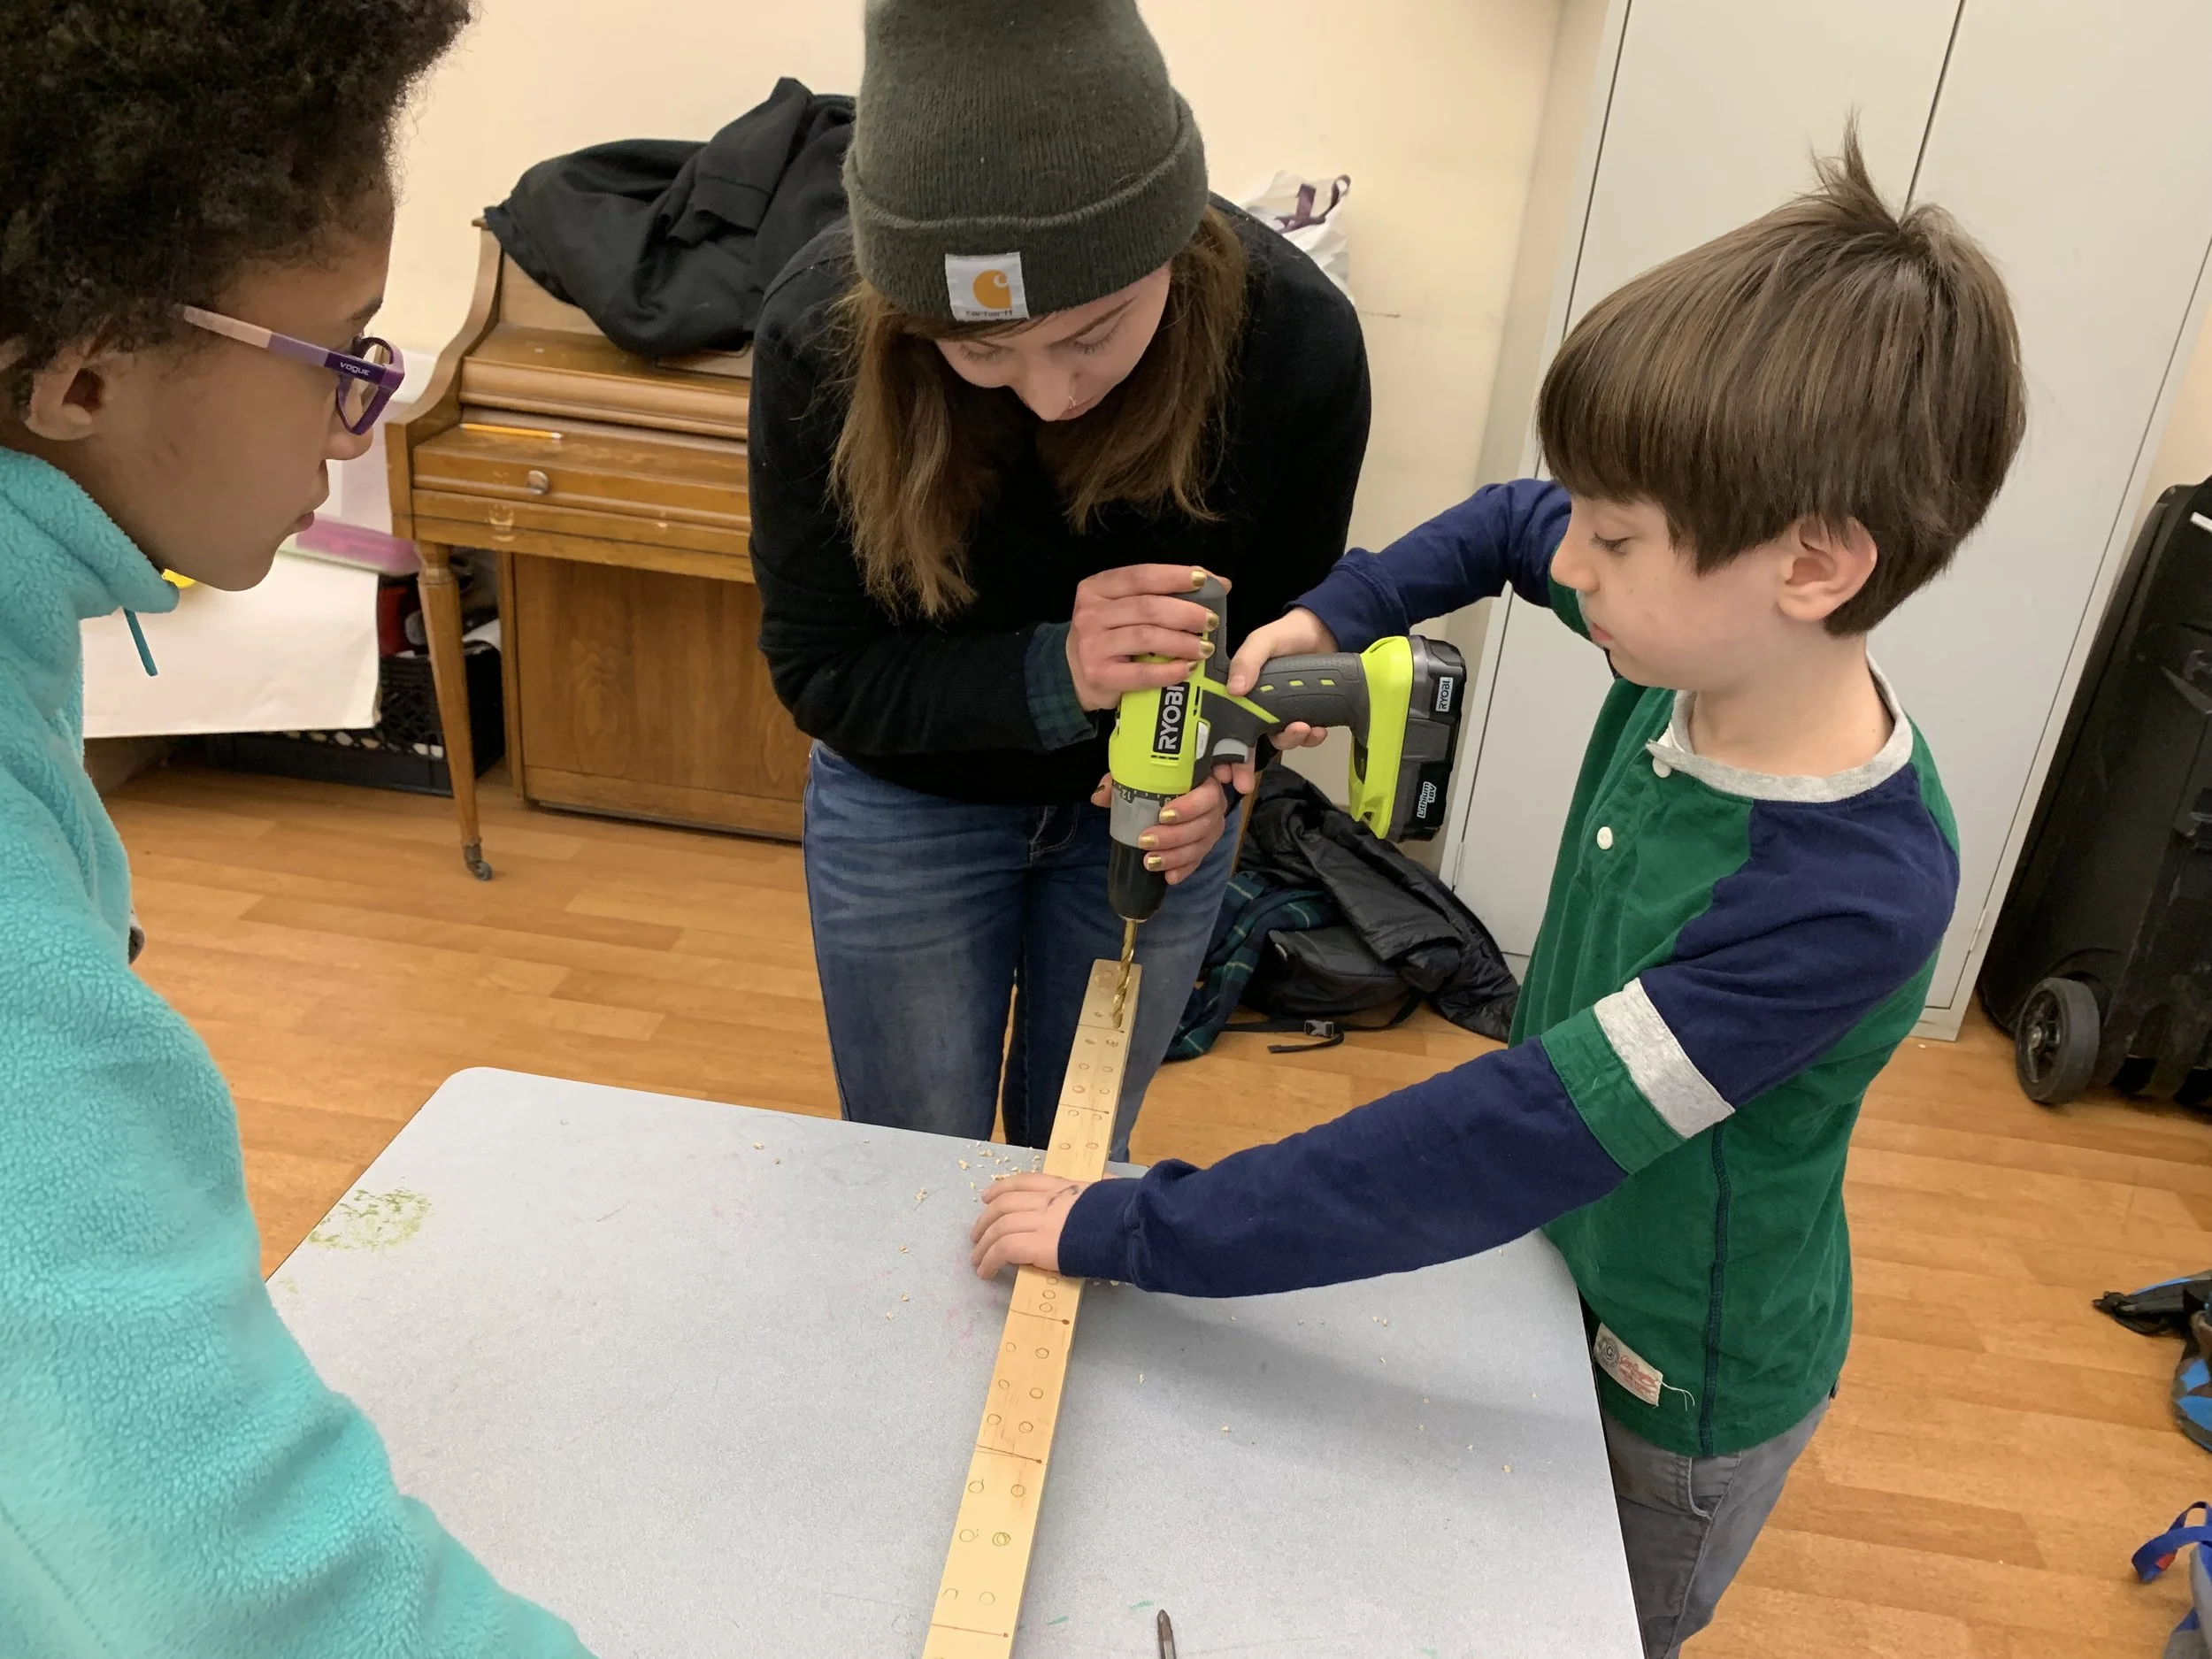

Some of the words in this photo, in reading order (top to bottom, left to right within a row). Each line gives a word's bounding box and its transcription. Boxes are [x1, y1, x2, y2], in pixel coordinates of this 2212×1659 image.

[1438, 680, 1450, 710] RYOBI
[1158, 686, 1185, 750] RYOBI
[1417, 781, 1430, 818] Lithium
